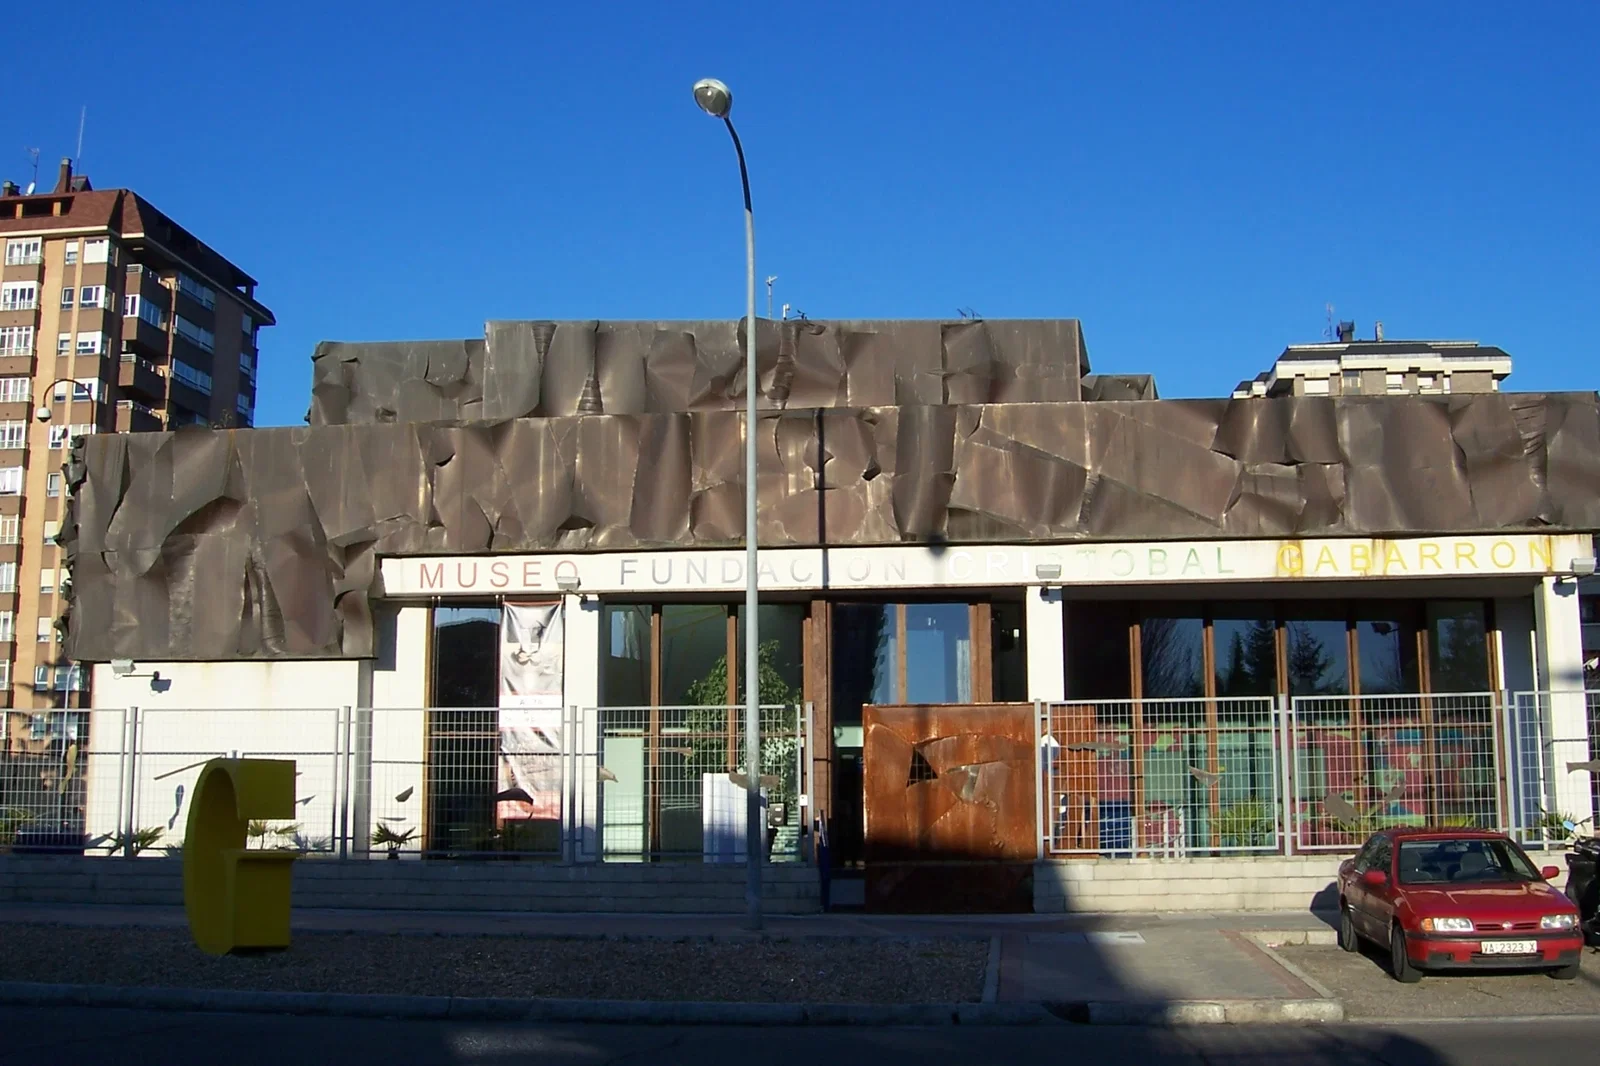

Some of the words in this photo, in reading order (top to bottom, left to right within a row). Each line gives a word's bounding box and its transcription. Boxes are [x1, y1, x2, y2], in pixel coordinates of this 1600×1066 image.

[420, 561, 578, 588] MUSEO
[621, 557, 906, 585] FUNDACON
[1278, 541, 1550, 574] GABARRON
